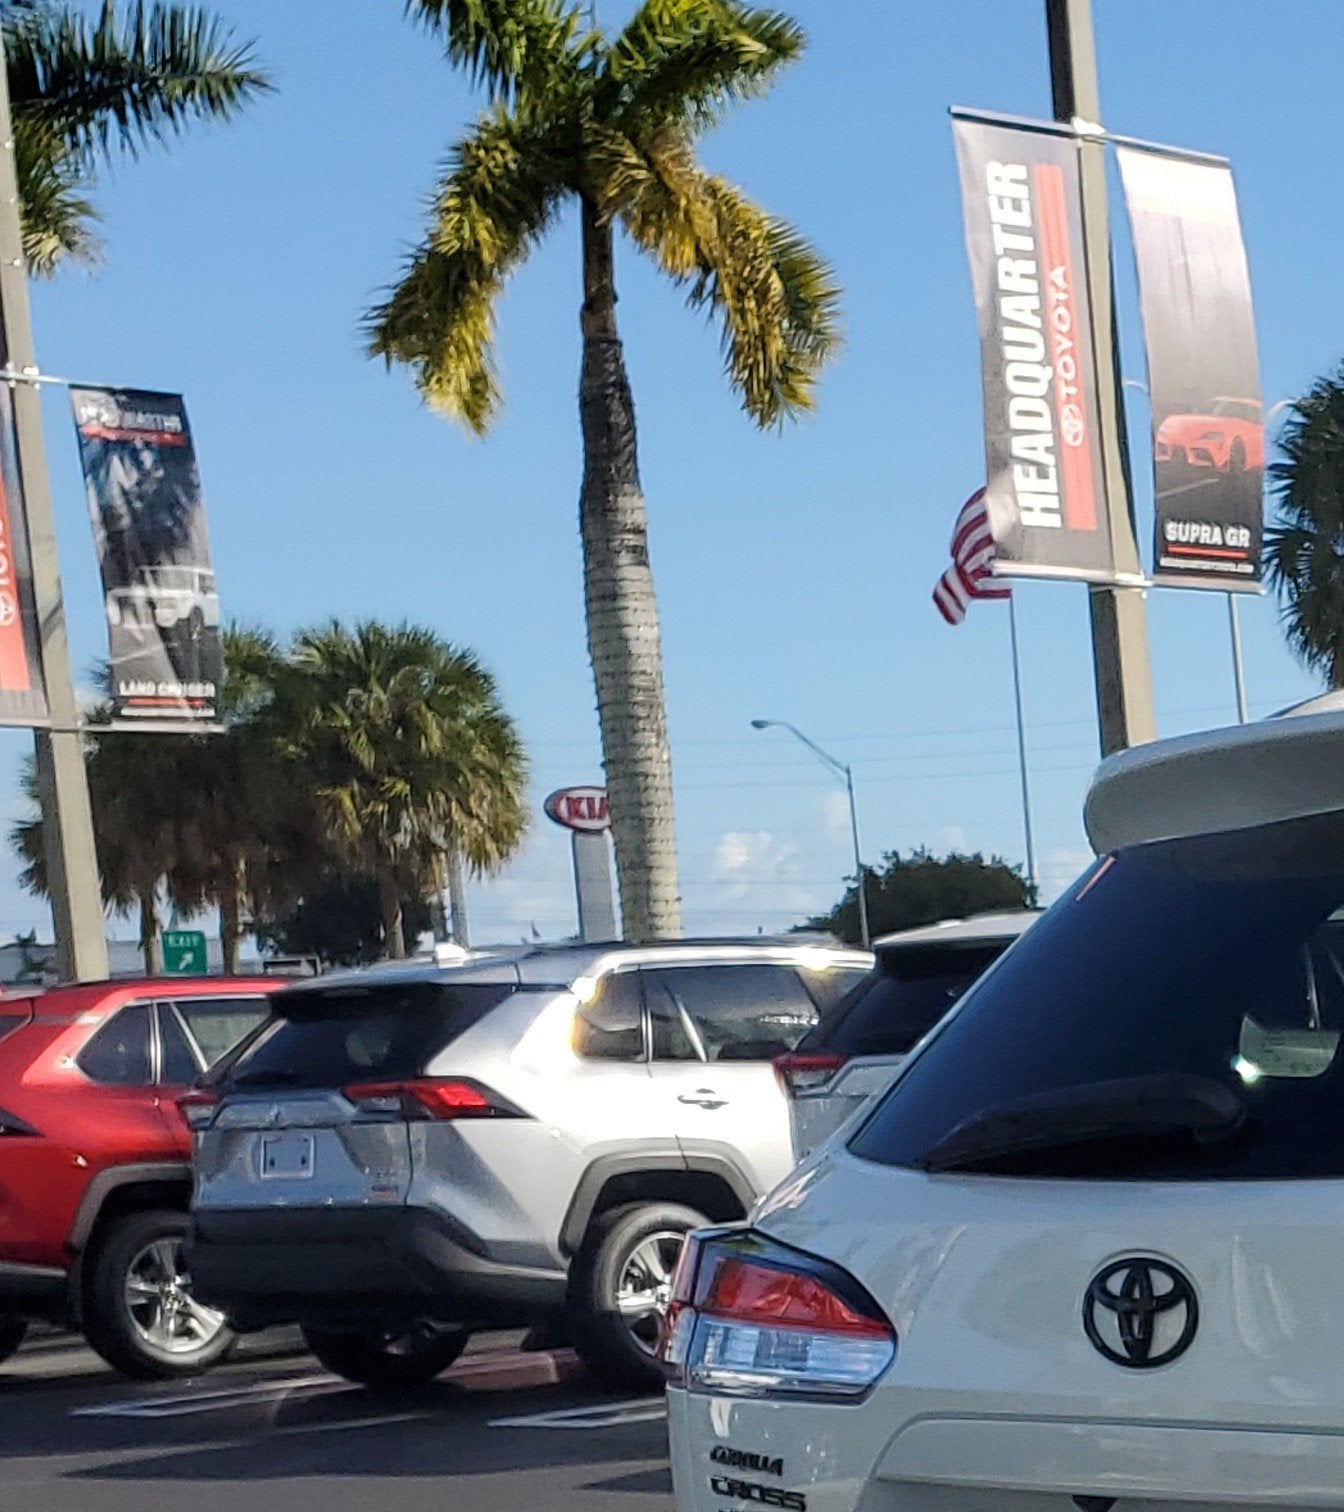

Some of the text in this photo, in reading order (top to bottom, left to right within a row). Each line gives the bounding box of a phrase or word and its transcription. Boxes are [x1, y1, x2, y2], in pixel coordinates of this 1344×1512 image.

[985, 160, 1062, 529] HEADQUARTER
[1048, 265, 1078, 403] TOYOTA
[1165, 519, 1251, 548] SUPRA GR
[119, 680, 215, 698] LAND CRUISER
[168, 934, 200, 948] EXIT
[710, 1475, 807, 1512] CROSS
